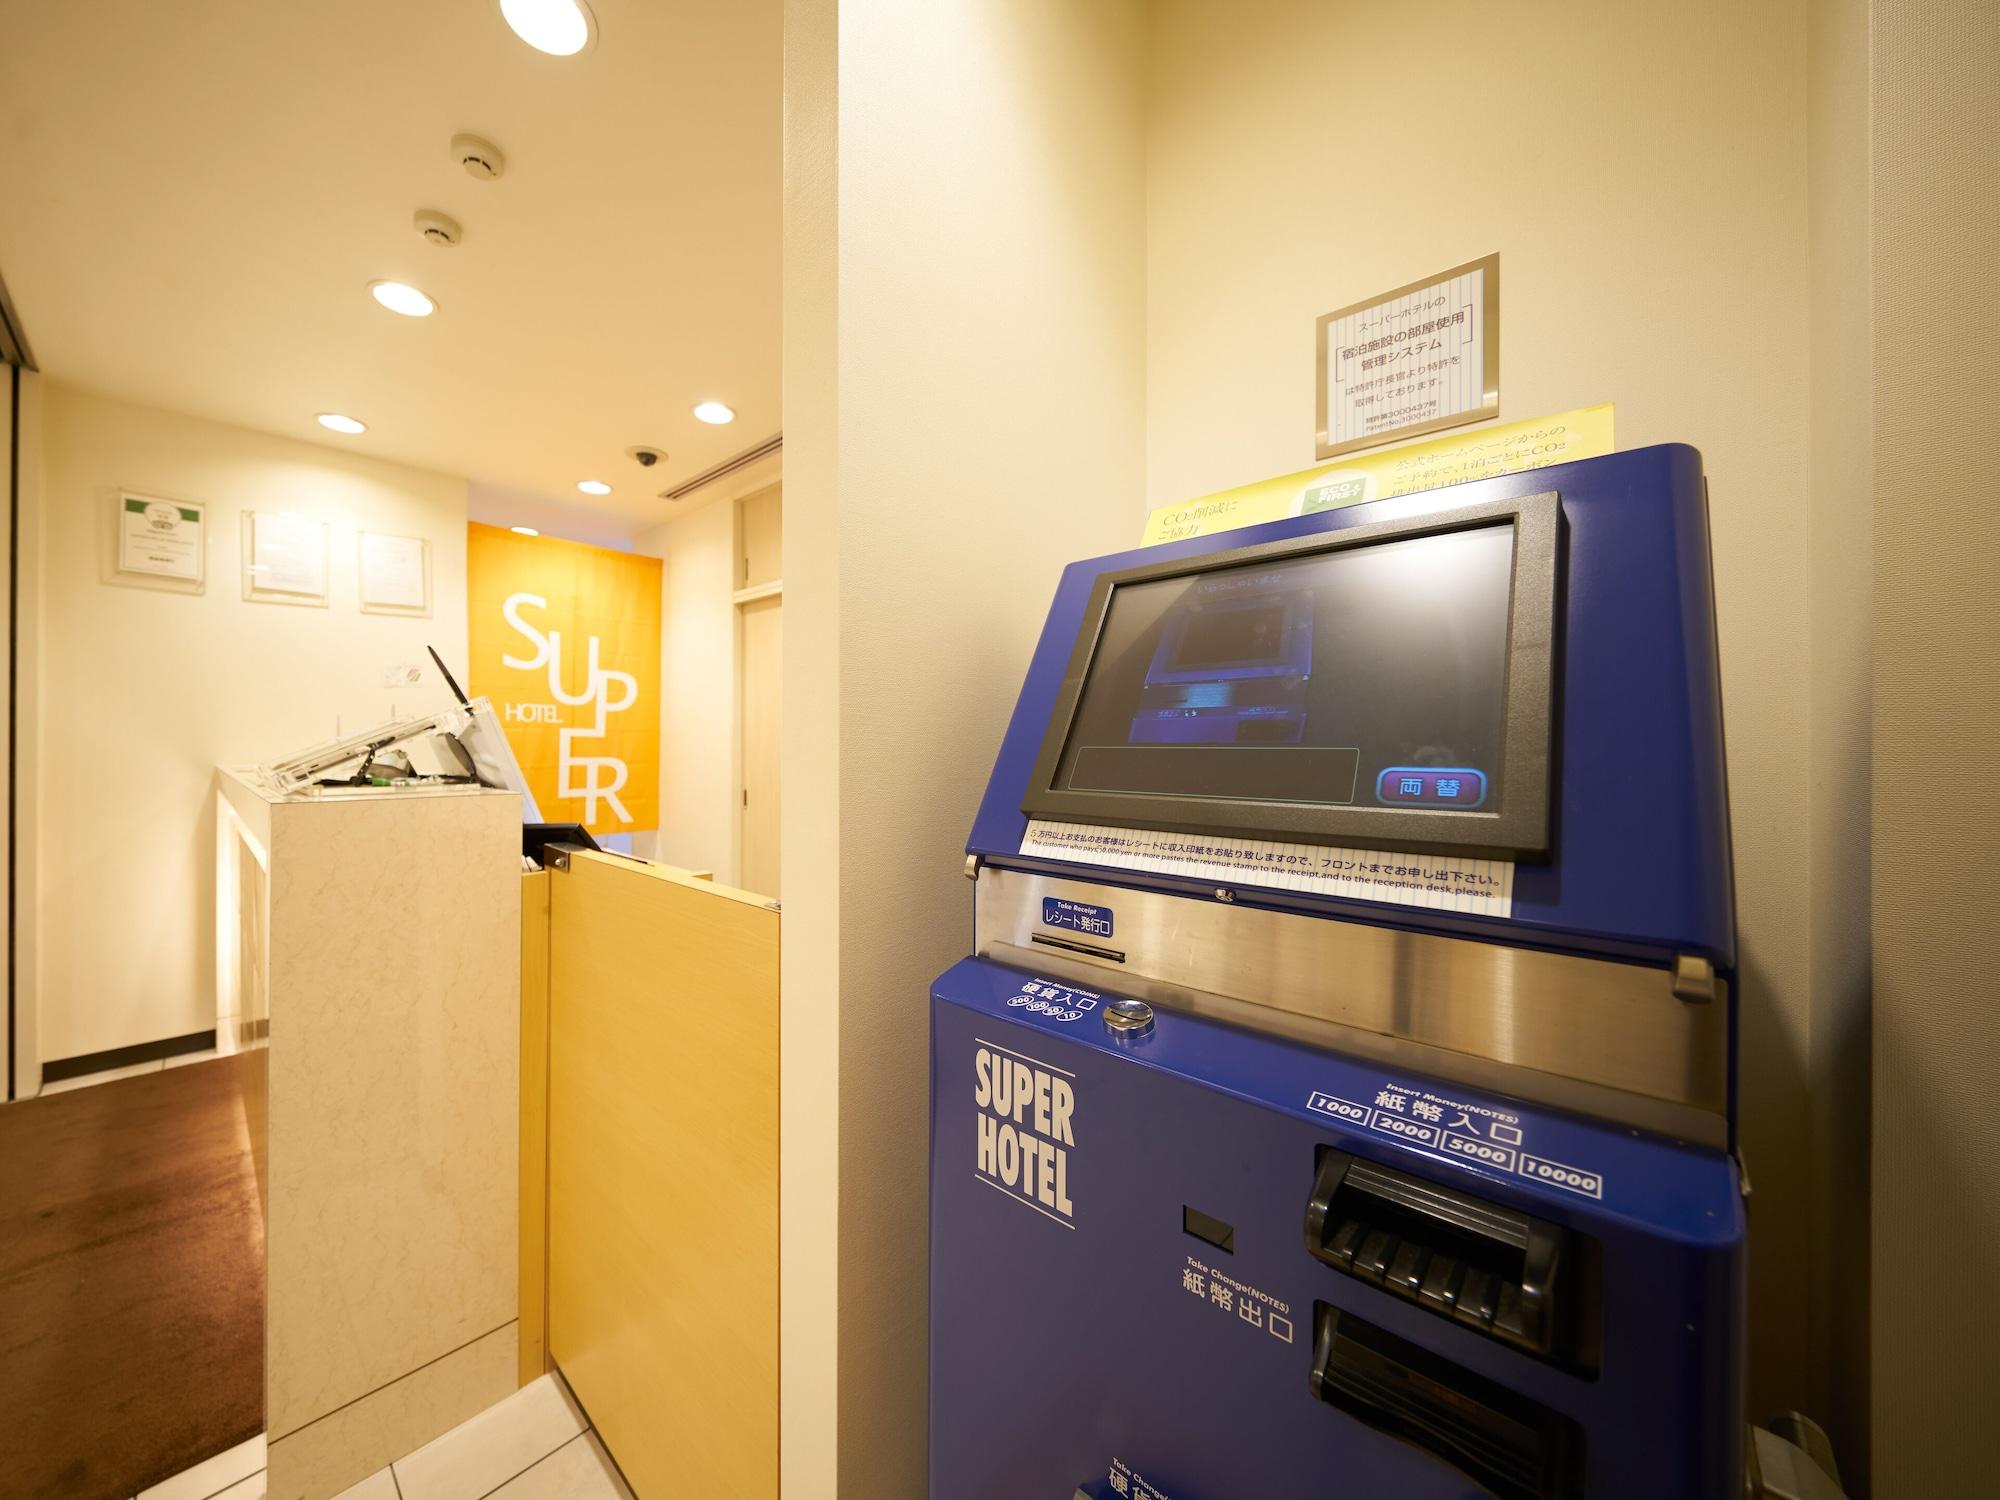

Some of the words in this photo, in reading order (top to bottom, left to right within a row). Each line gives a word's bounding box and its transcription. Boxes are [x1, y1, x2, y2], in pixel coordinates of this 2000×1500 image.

[1359, 296, 1446, 333] スーパーホテルの
[1342, 311, 1465, 361] 宿泊施設の部屋使用
[1361, 338, 1442, 372] 管理システム
[1320, 483, 1350, 497] ECO
[502, 592, 639, 825] SUPER
[505, 702, 564, 723] HOTEL
[1400, 778, 1461, 797] 両替
[1042, 841, 1068, 849] customer
[1142, 852, 1160, 860] more
[1161, 854, 1185, 862] pastes
[1186, 856, 1199, 864] the
[1200, 859, 1231, 867] revenue
[1233, 862, 1258, 871] stamp
[1260, 864, 1269, 872] to
[1271, 866, 1286, 874] the
[1341, 874, 1351, 882] to
[1354, 875, 1371, 884] the
[1373, 878, 1423, 890] reception
[1045, 909, 1110, 934] レシート発行口
[1057, 901, 1072, 911] Take
[1073, 904, 1097, 915] Receipt
[1012, 997, 1030, 1005] 500
[975, 1048, 1075, 1148] SUPER
[1374, 1091, 1523, 1146] 紙幣入口
[1386, 1083, 1420, 1098] Insert
[1423, 1092, 1519, 1125] Money(NOTES)
[977, 1111, 1073, 1218] HOTEL
[1316, 1097, 1363, 1120] 1000
[1379, 1117, 1431, 1141] 2000
[1448, 1137, 1507, 1164] 5000
[1526, 1159, 1598, 1192] 10000
[1182, 1268, 1294, 1344] 紙幣出口
[1187, 1256, 1208, 1273] Take
[1210, 1268, 1290, 1314] Change(NOTES)
[1112, 1456, 1131, 1476] Take
